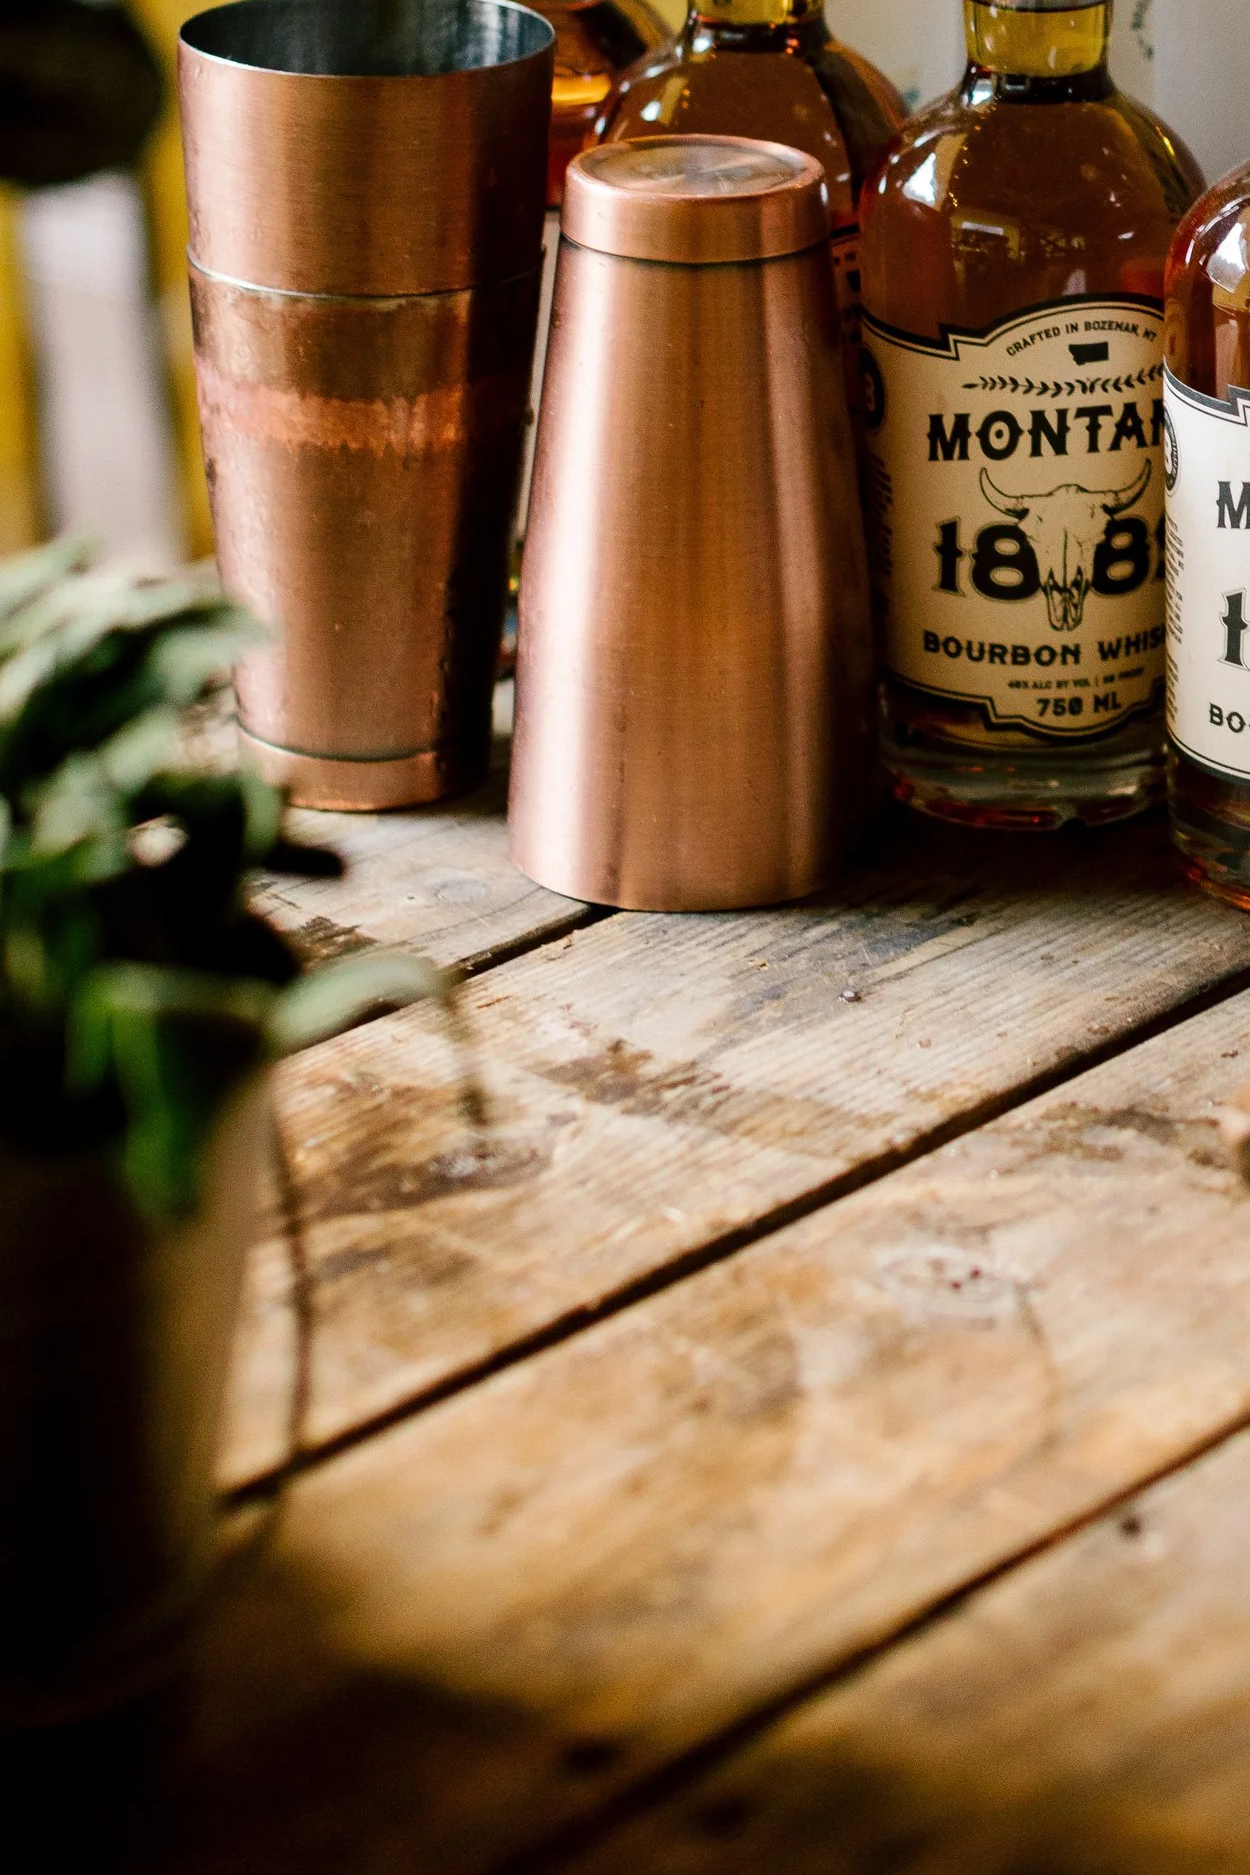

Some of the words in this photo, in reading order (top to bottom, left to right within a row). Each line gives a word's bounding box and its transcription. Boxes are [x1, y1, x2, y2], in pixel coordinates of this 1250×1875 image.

[1006, 326, 1061, 356] CRAFTED
[1065, 322, 1079, 334] IN
[933, 515, 1165, 602] 188
[923, 629, 1081, 667] BOURBON
[1098, 626, 1165, 662] WHIS
[1037, 696, 1084, 717] 750
[1093, 690, 1120, 714] ML
